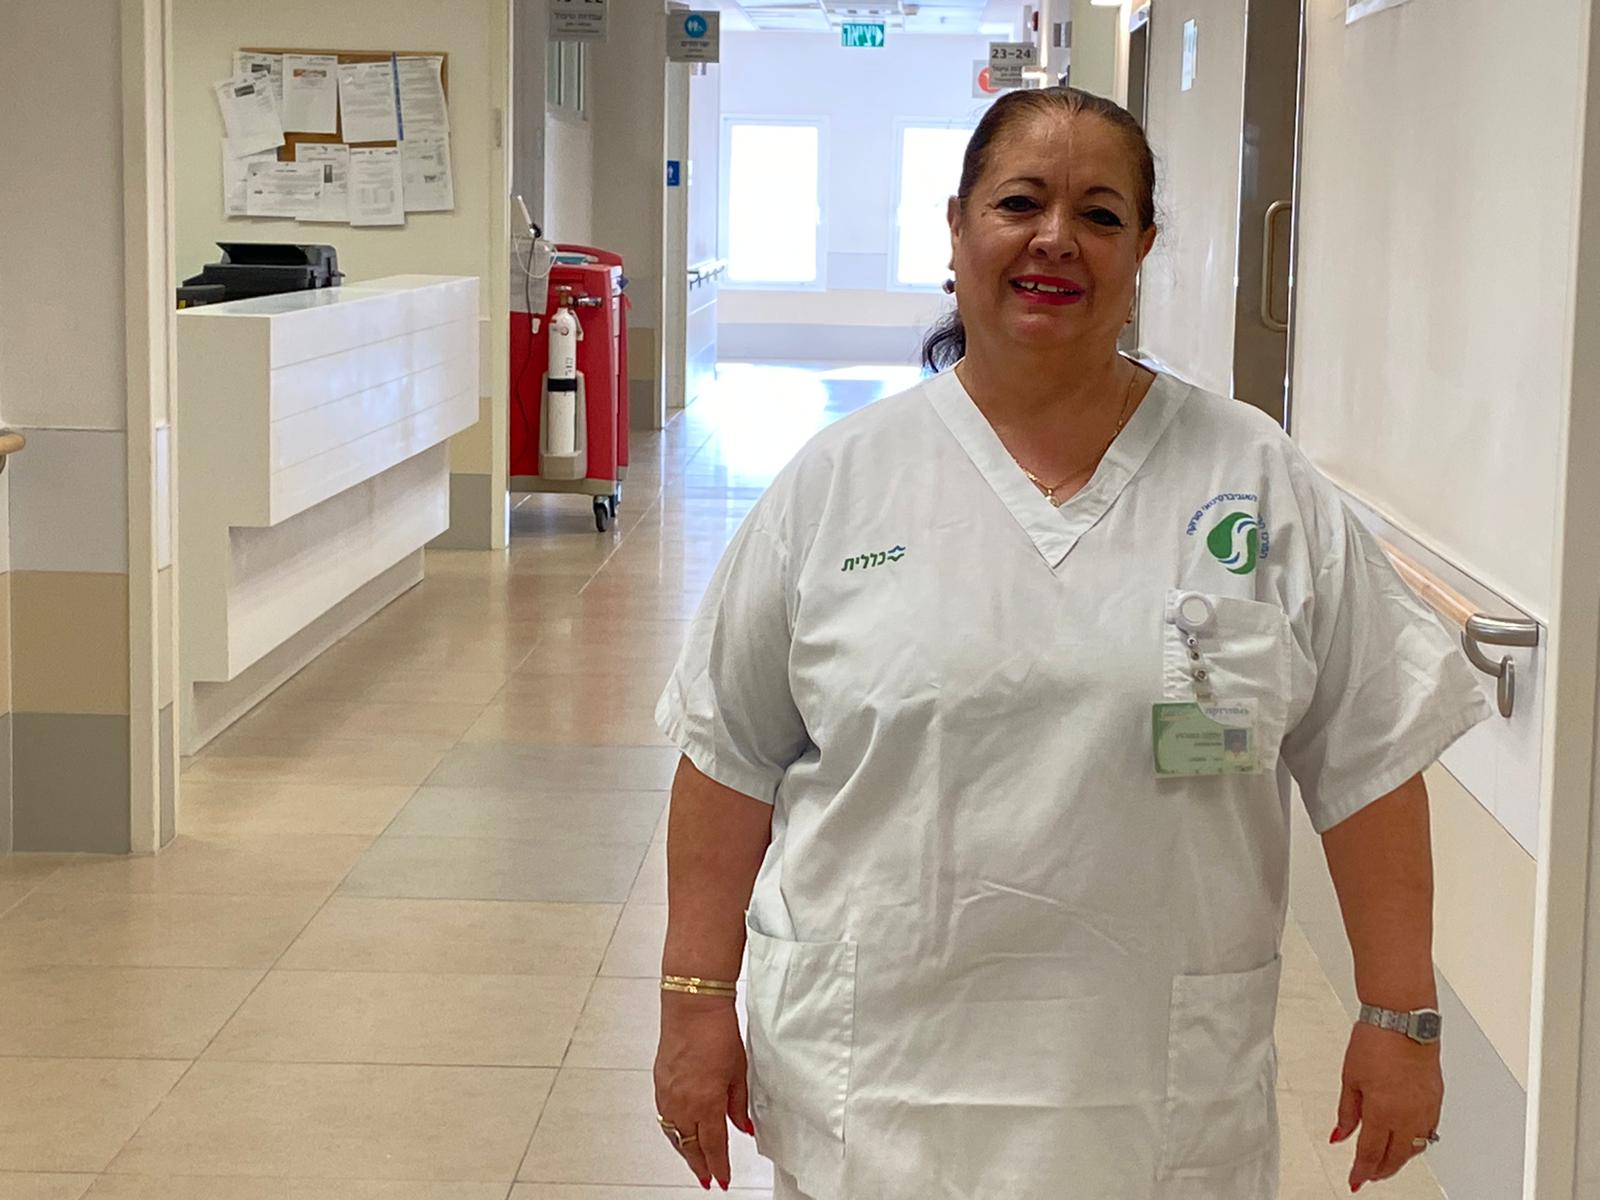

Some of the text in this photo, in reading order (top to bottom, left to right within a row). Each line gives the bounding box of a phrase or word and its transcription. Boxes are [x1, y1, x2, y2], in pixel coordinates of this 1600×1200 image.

[843, 25, 875, 47] יציאה
[991, 48, 1031, 59] 23-24
[841, 551, 886, 572] כללית
